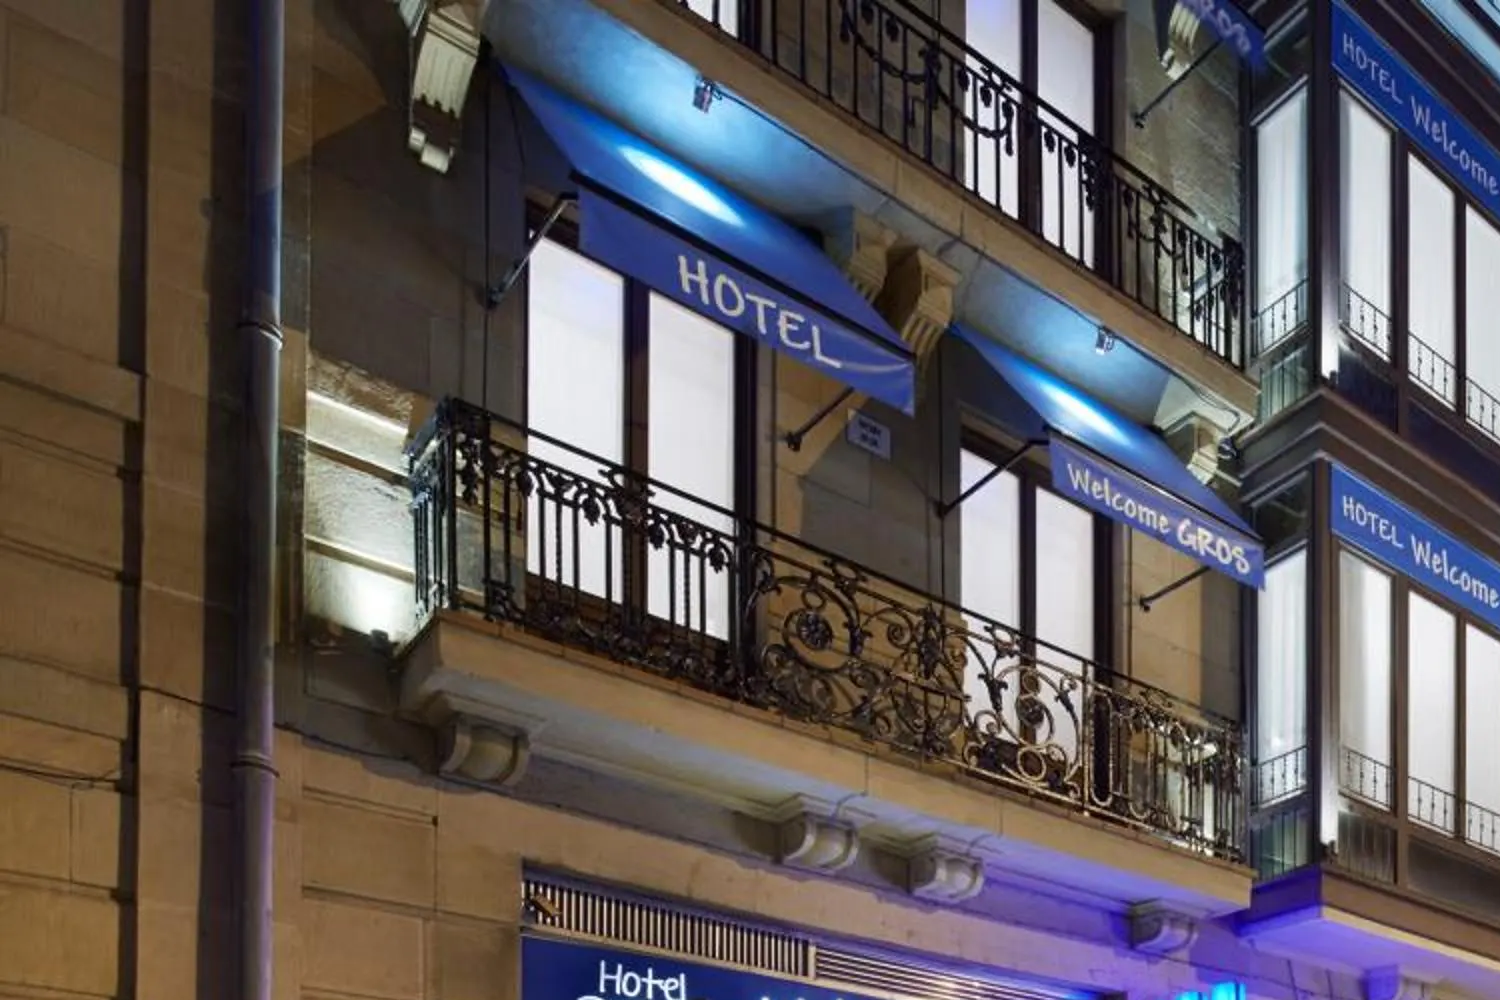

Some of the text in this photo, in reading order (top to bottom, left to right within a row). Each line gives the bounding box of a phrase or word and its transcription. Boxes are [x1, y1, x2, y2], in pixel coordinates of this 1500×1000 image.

[1180, 0, 1251, 54] ROS
[1342, 33, 1404, 104] HOTEL
[1411, 95, 1499, 195] Welcome
[678, 254, 843, 369] HOTEL
[1067, 463, 1250, 574] Welcome GROS
[1342, 495, 1405, 549] HOTEL
[1411, 534, 1500, 609] Welcome
